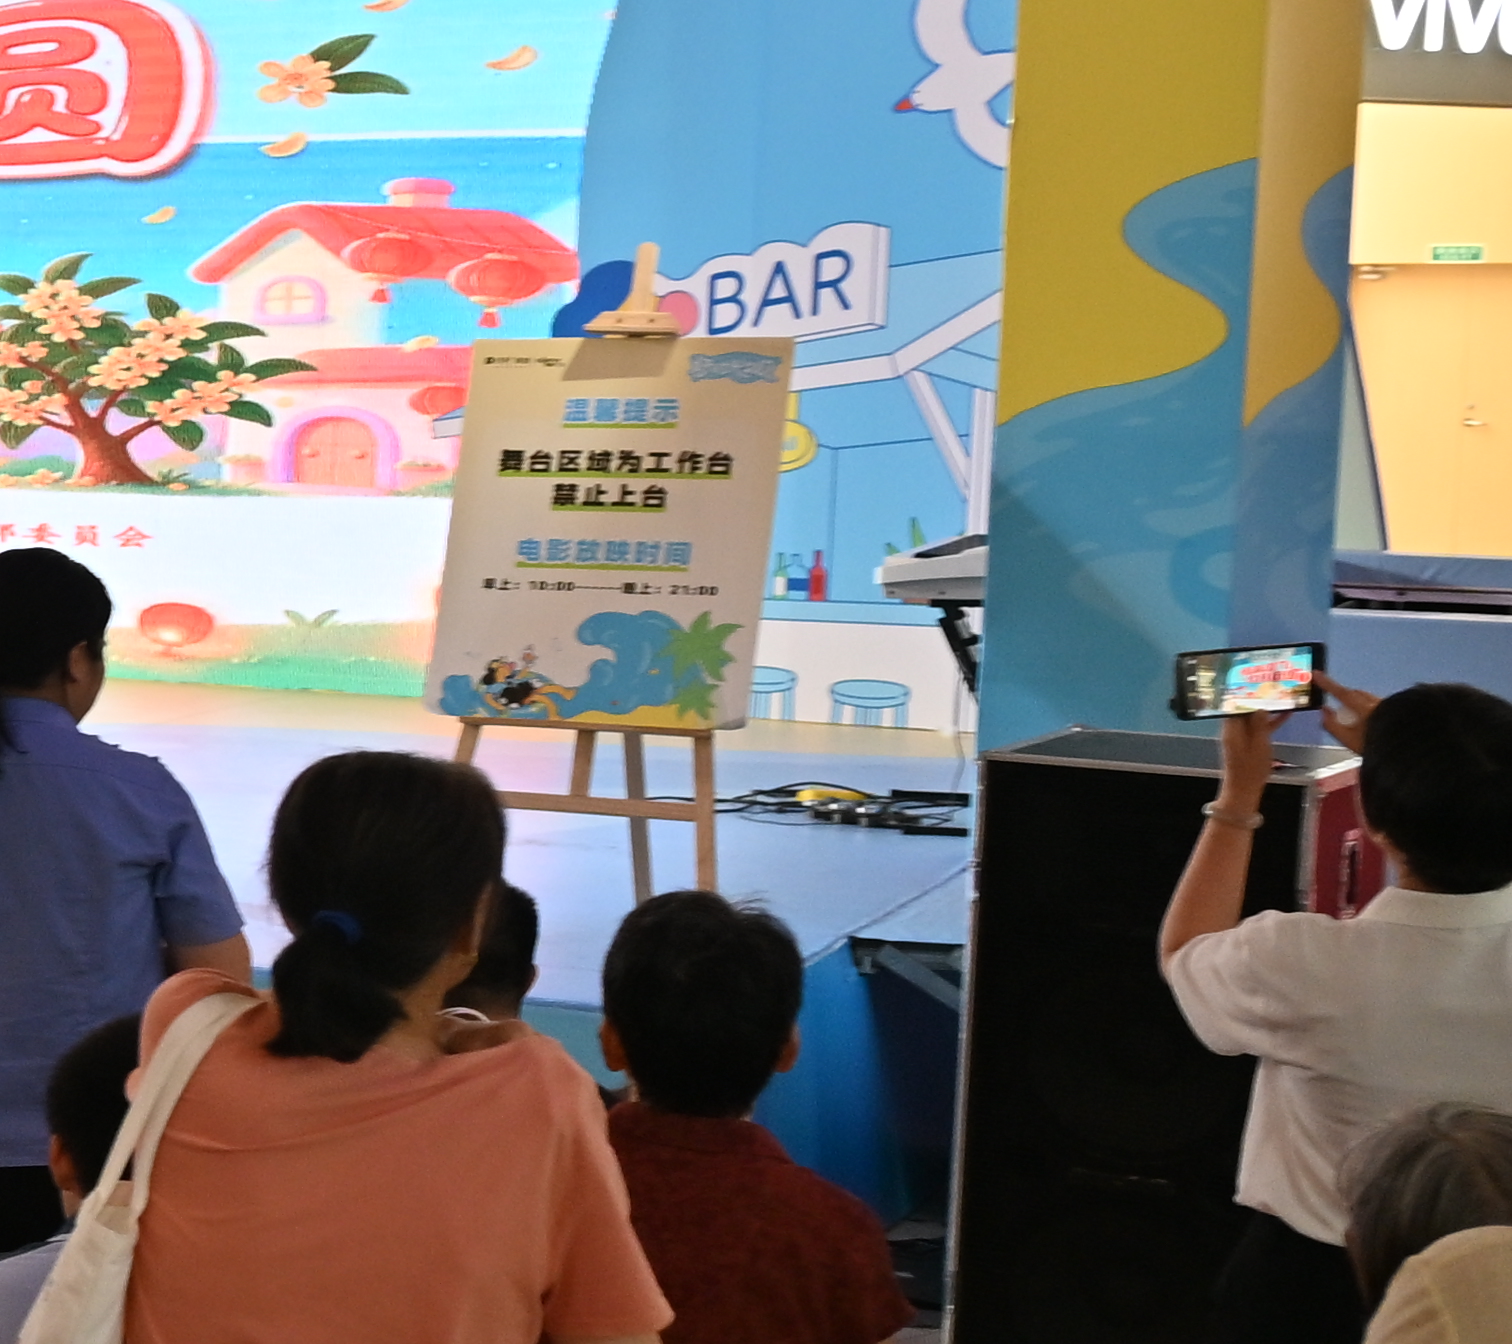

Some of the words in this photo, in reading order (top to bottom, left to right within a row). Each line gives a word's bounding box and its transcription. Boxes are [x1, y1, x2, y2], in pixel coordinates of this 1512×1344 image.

[708, 249, 854, 336] BAR
[498, 449, 735, 476] 舞台区域为工作台
[552, 482, 669, 508] 禁止上台
[517, 537, 693, 566] 电影放映时间
